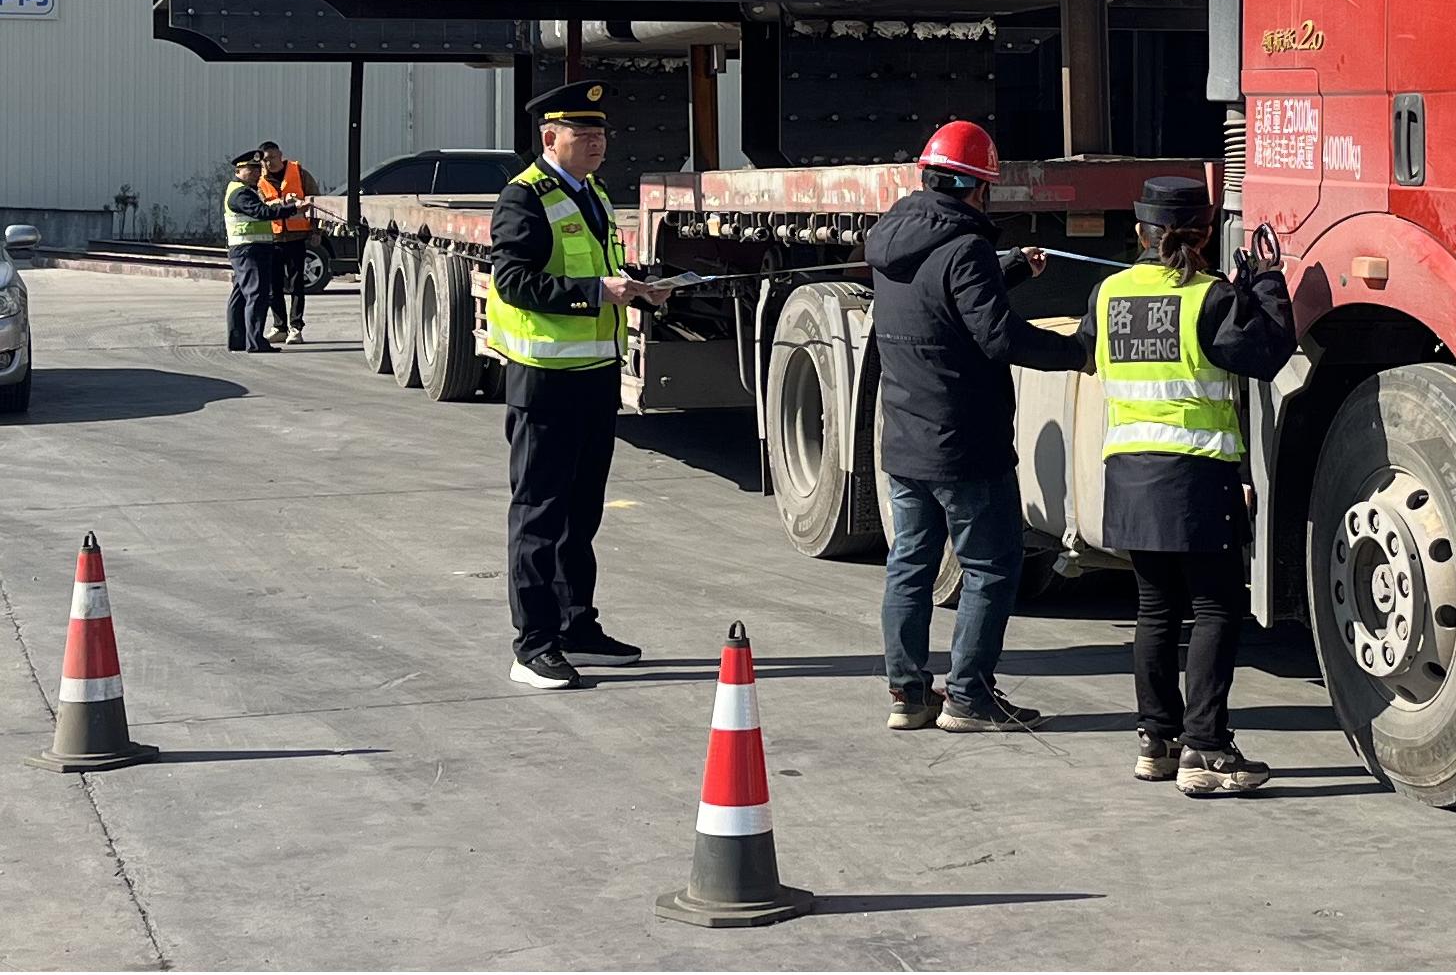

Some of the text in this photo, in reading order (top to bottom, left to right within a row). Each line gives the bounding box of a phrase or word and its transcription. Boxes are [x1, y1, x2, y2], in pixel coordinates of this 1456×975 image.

[1297, 19, 1325, 51] 2.0
[1108, 338, 1179, 361] LU ZHENG
